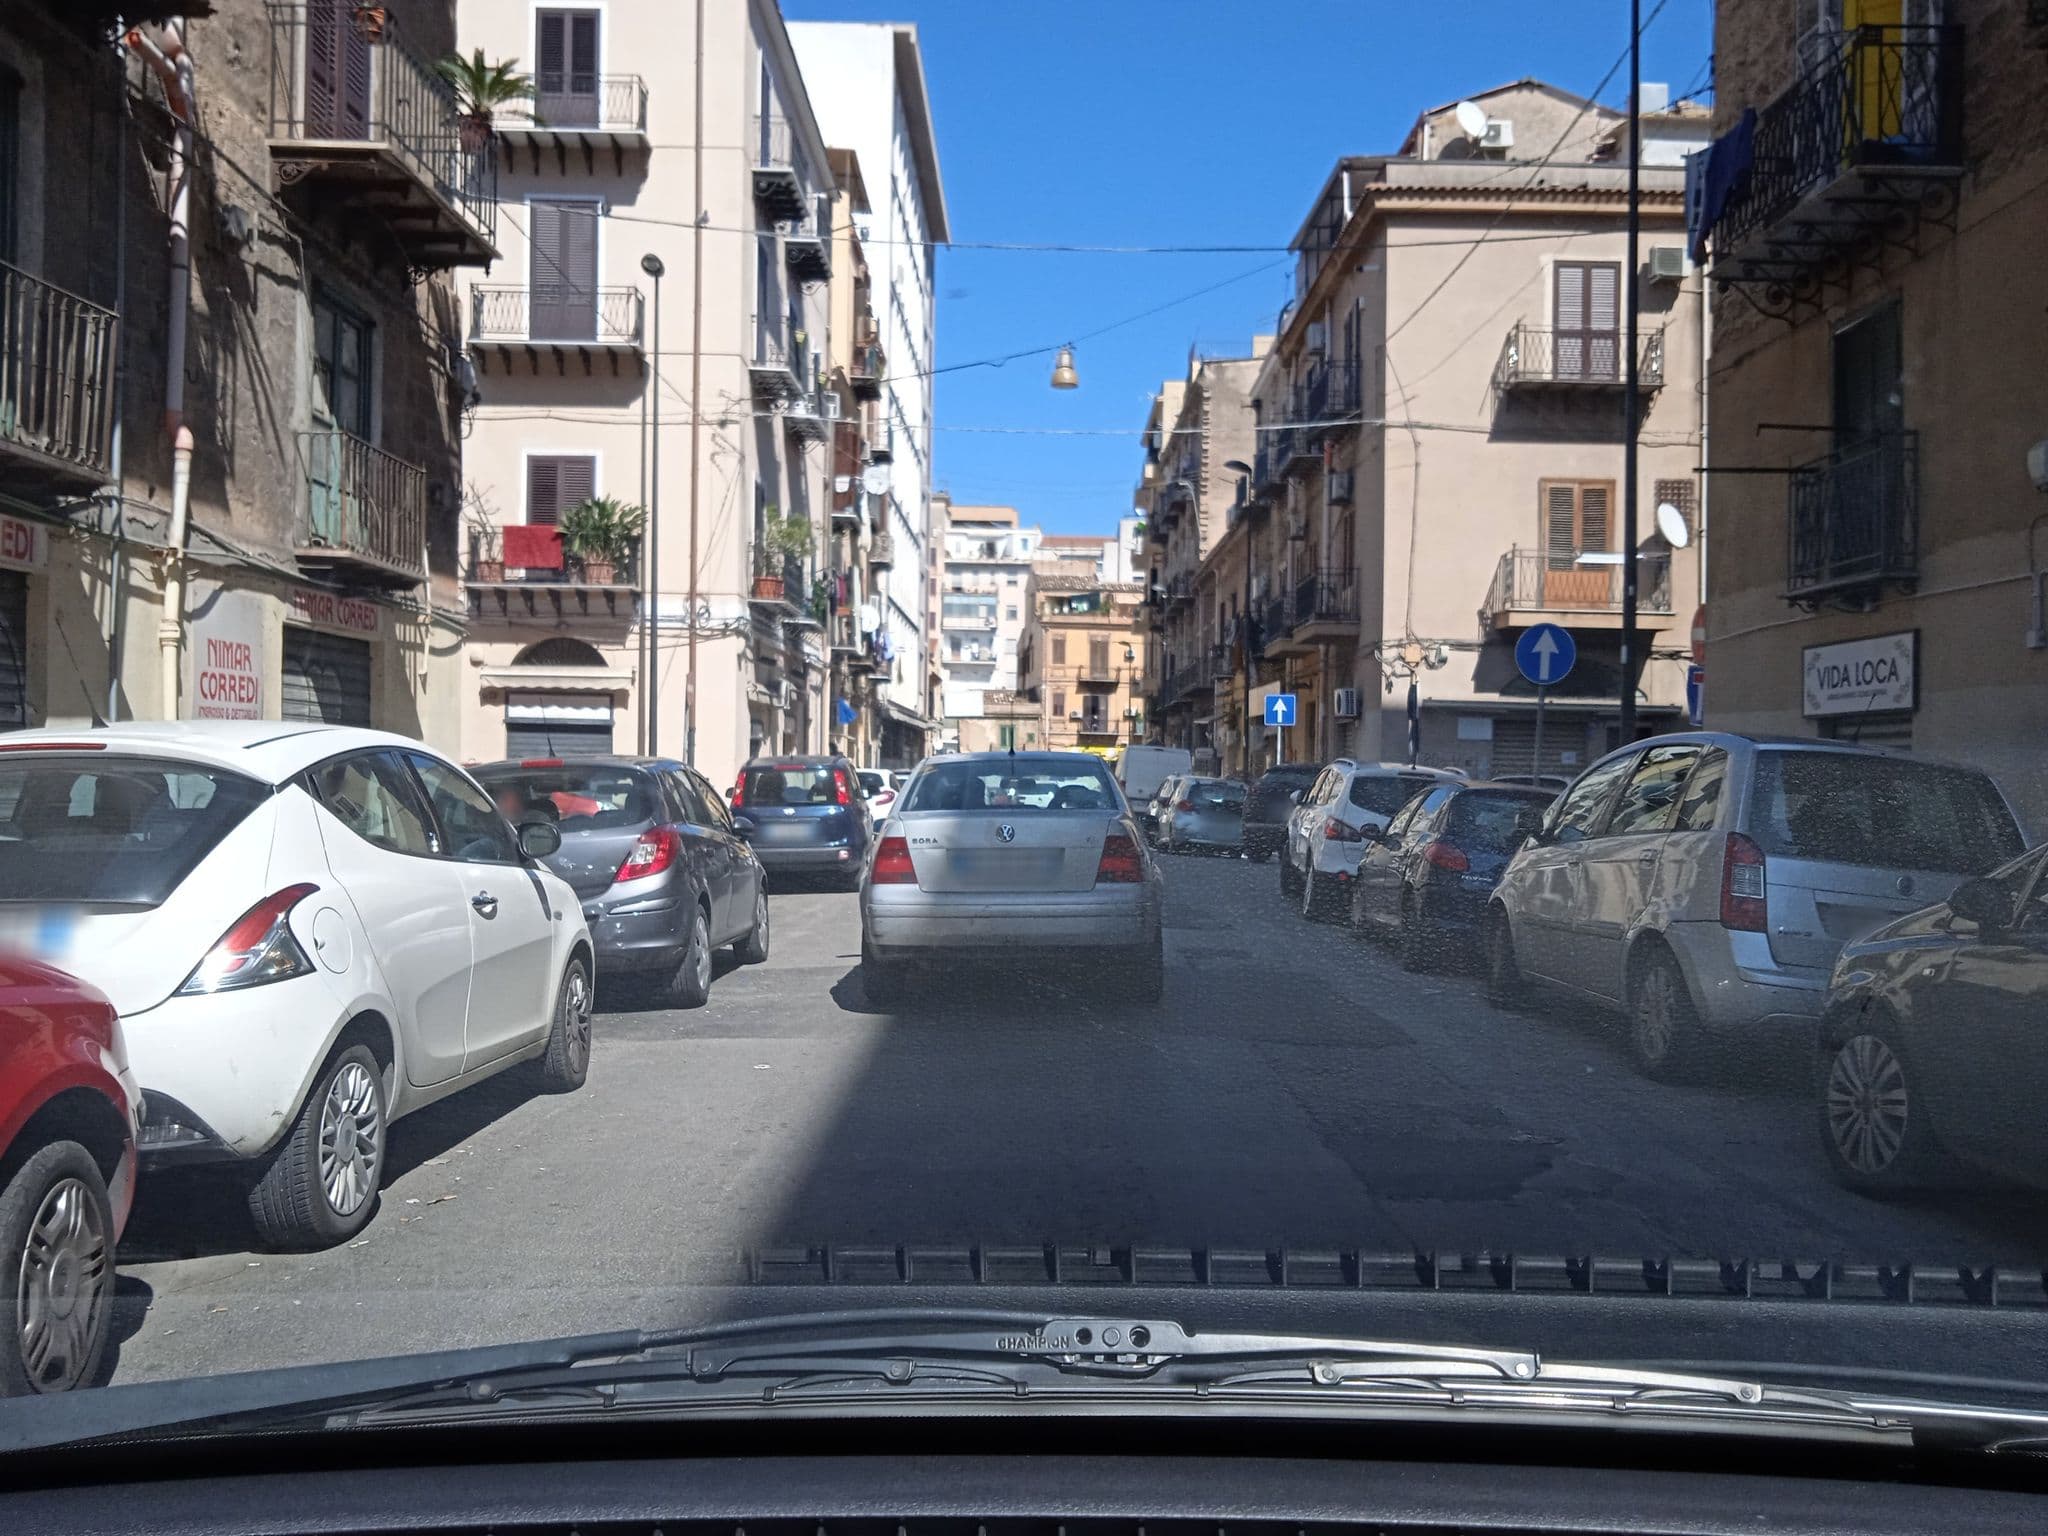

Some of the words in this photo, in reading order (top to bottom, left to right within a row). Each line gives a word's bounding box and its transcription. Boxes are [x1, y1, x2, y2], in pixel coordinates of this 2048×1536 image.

[337, 599, 378, 632] CORREDI
[206, 638, 252, 672] NIMAR
[199, 671, 258, 705] CORREDI
[1817, 664, 1852, 690] VIDA
[1855, 657, 1899, 687] LOCA
[995, 1335, 1070, 1350] CHAMPION
